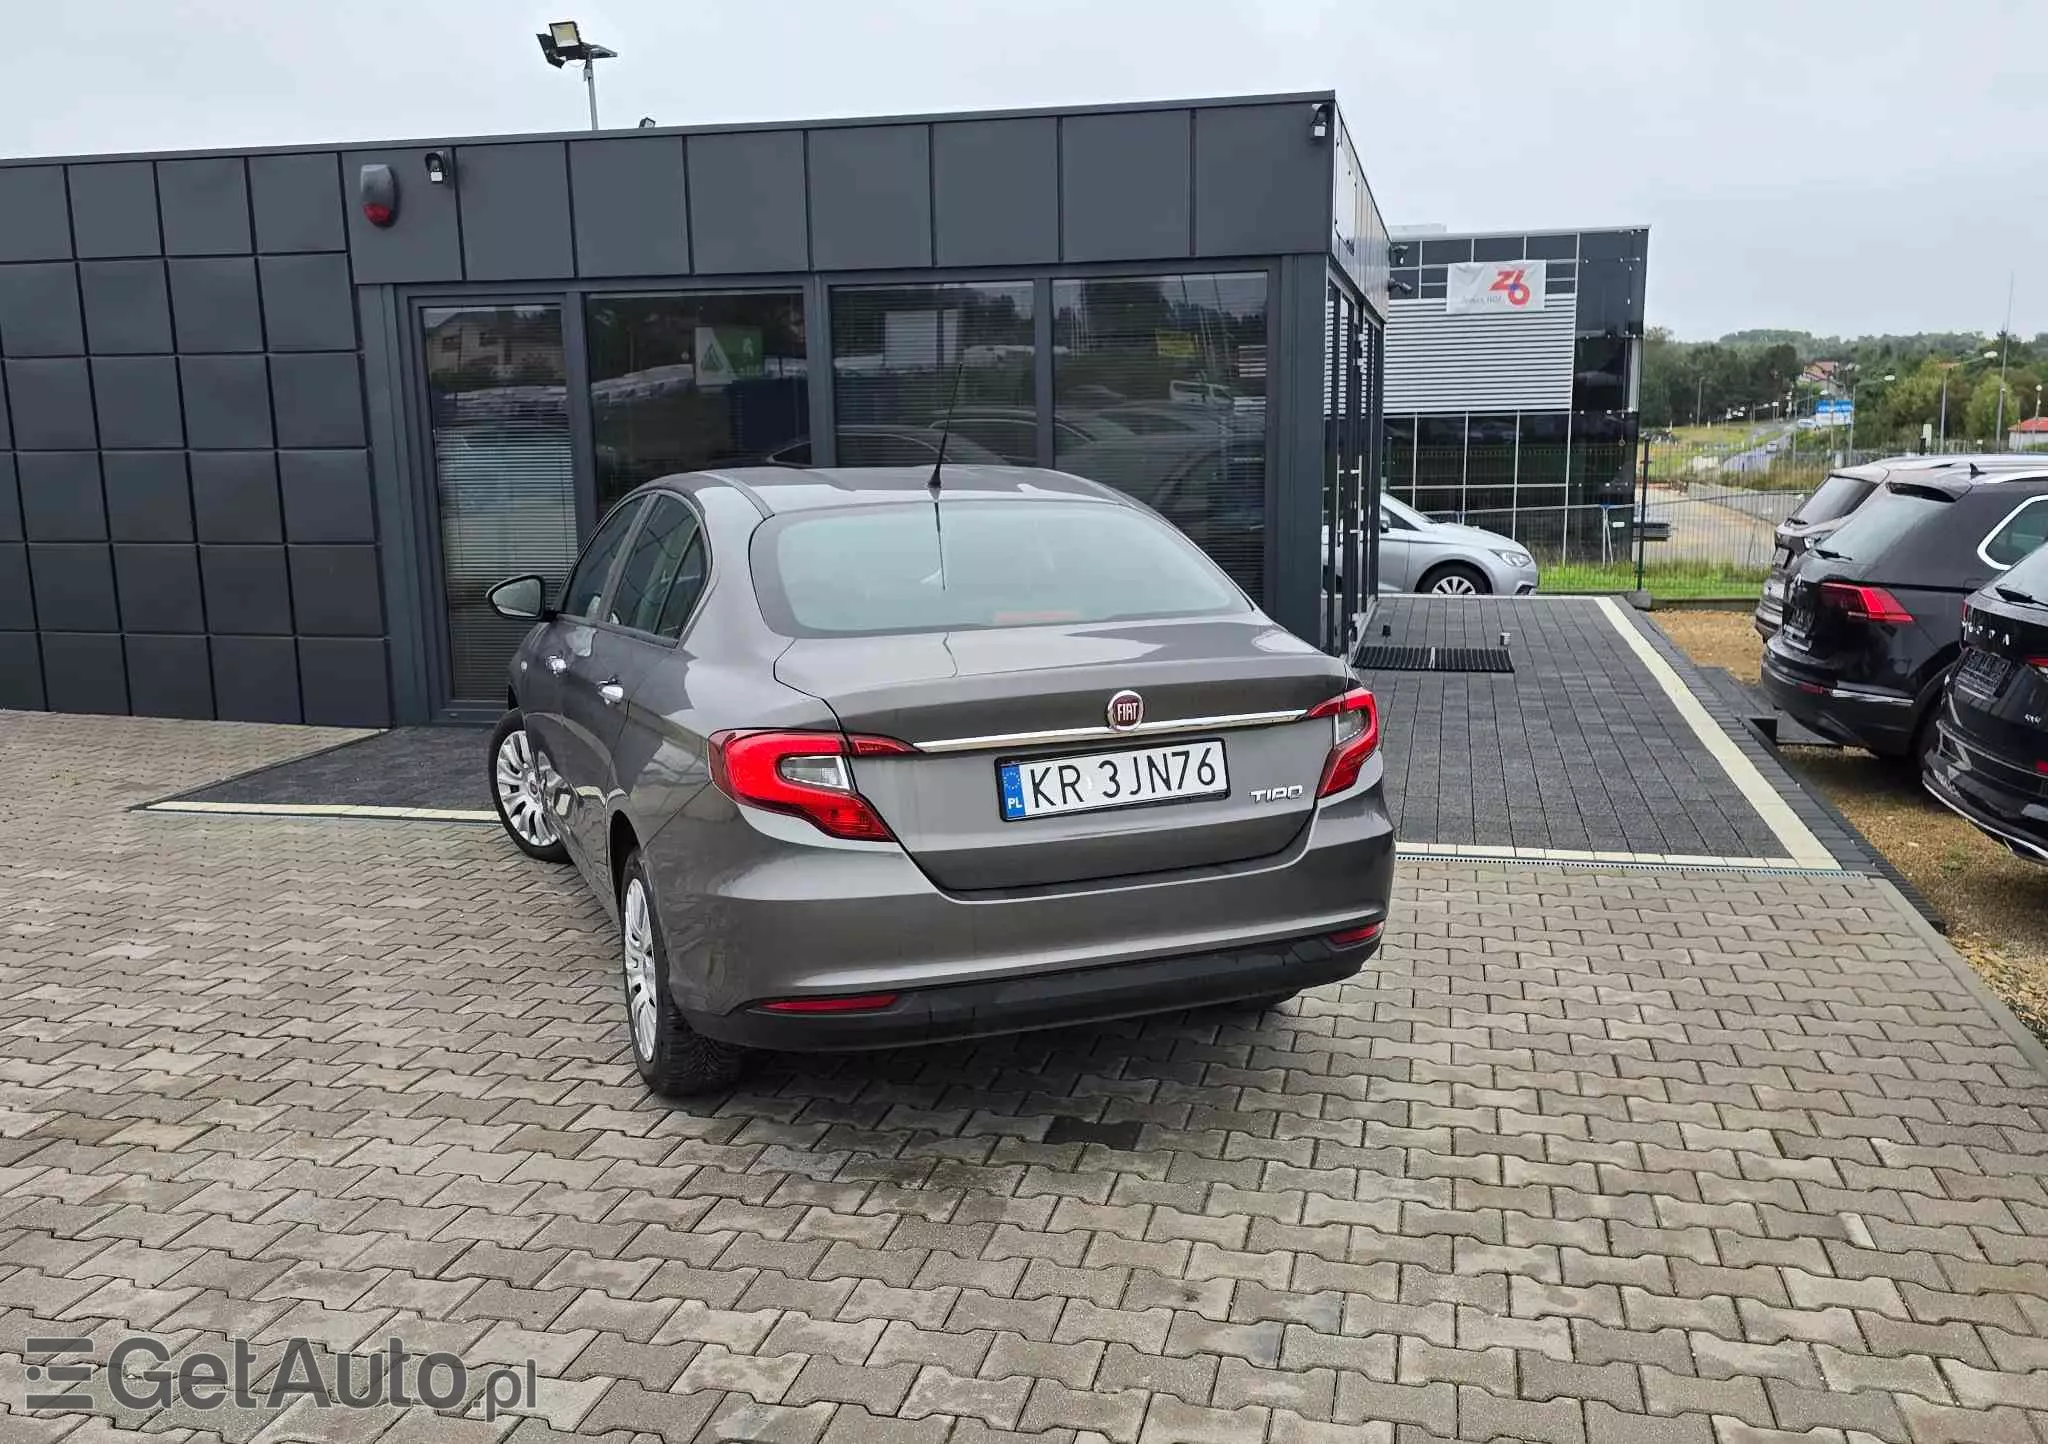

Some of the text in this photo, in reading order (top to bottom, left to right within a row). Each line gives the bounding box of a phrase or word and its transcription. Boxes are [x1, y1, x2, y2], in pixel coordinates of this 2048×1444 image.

[1117, 702, 1138, 721] FIAT
[1029, 747, 1216, 809] KR 3JN76
[1007, 798, 1023, 809] PL
[1250, 785, 1304, 804] TIPO
